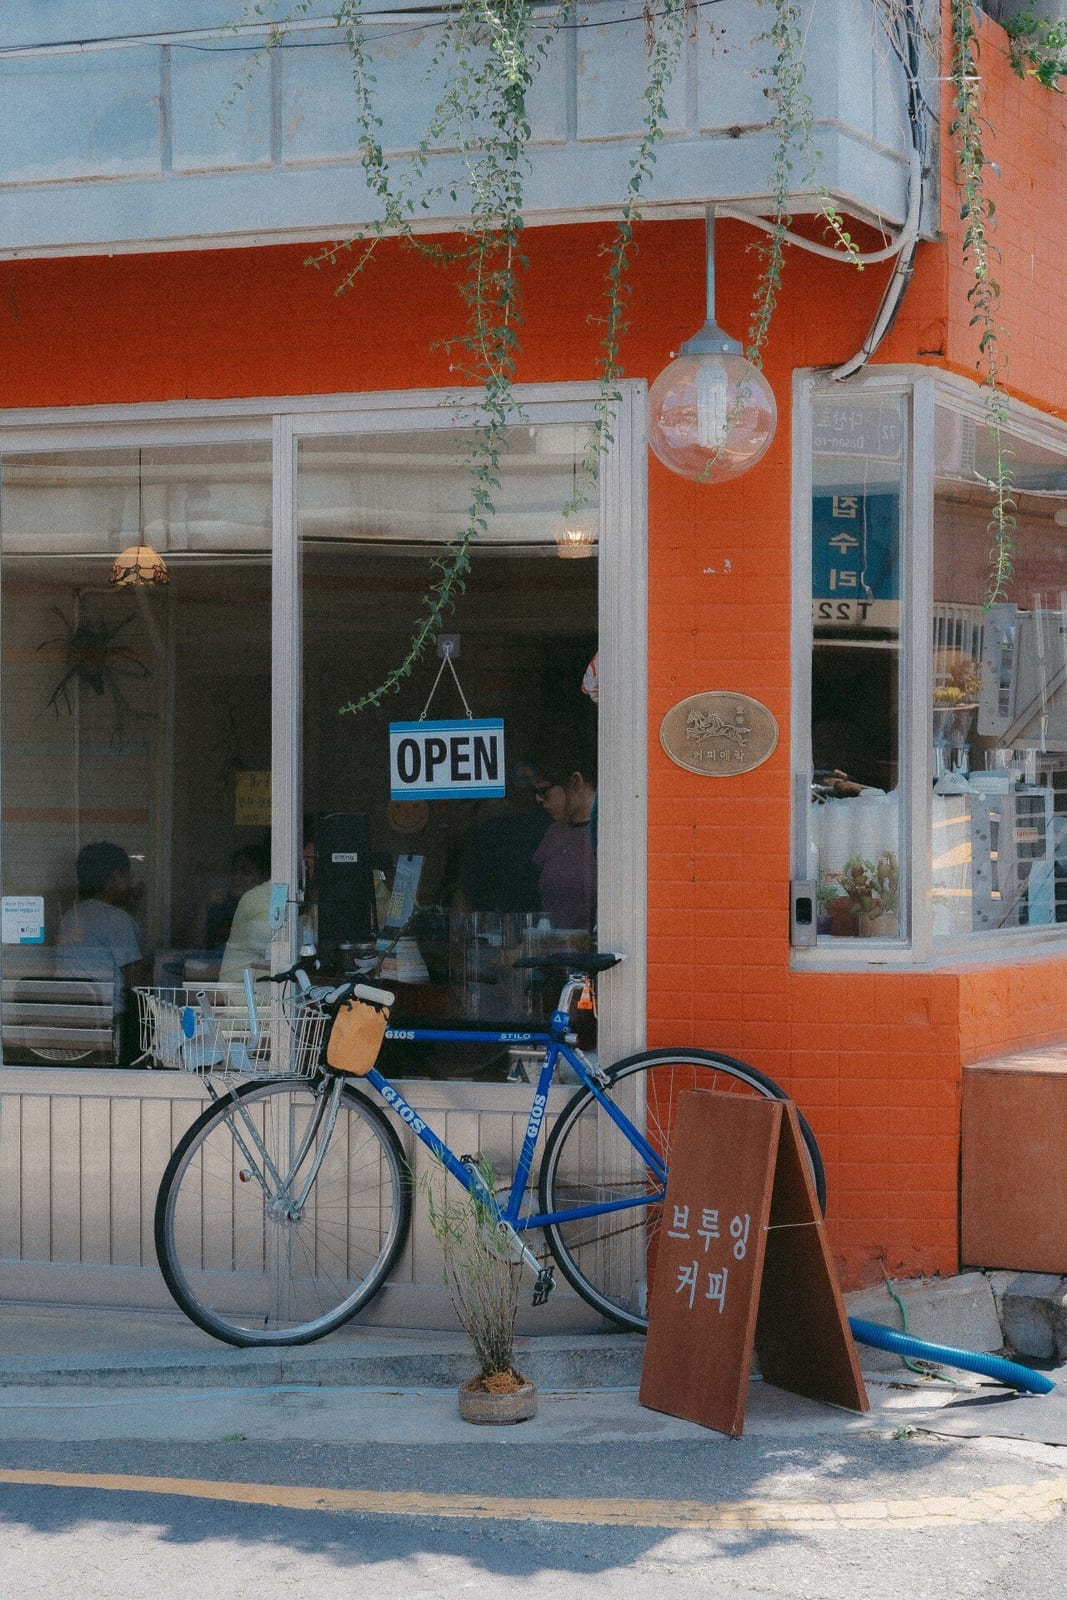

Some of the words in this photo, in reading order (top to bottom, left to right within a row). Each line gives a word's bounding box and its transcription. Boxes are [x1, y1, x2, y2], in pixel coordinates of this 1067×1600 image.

[397, 735, 498, 783] OPEN
[384, 1030, 415, 1040] GIOS
[381, 1086, 426, 1134] GIOS
[527, 1095, 546, 1138] GIOS
[667, 1204, 751, 1260] 브루잉
[675, 1260, 729, 1314] 커피
